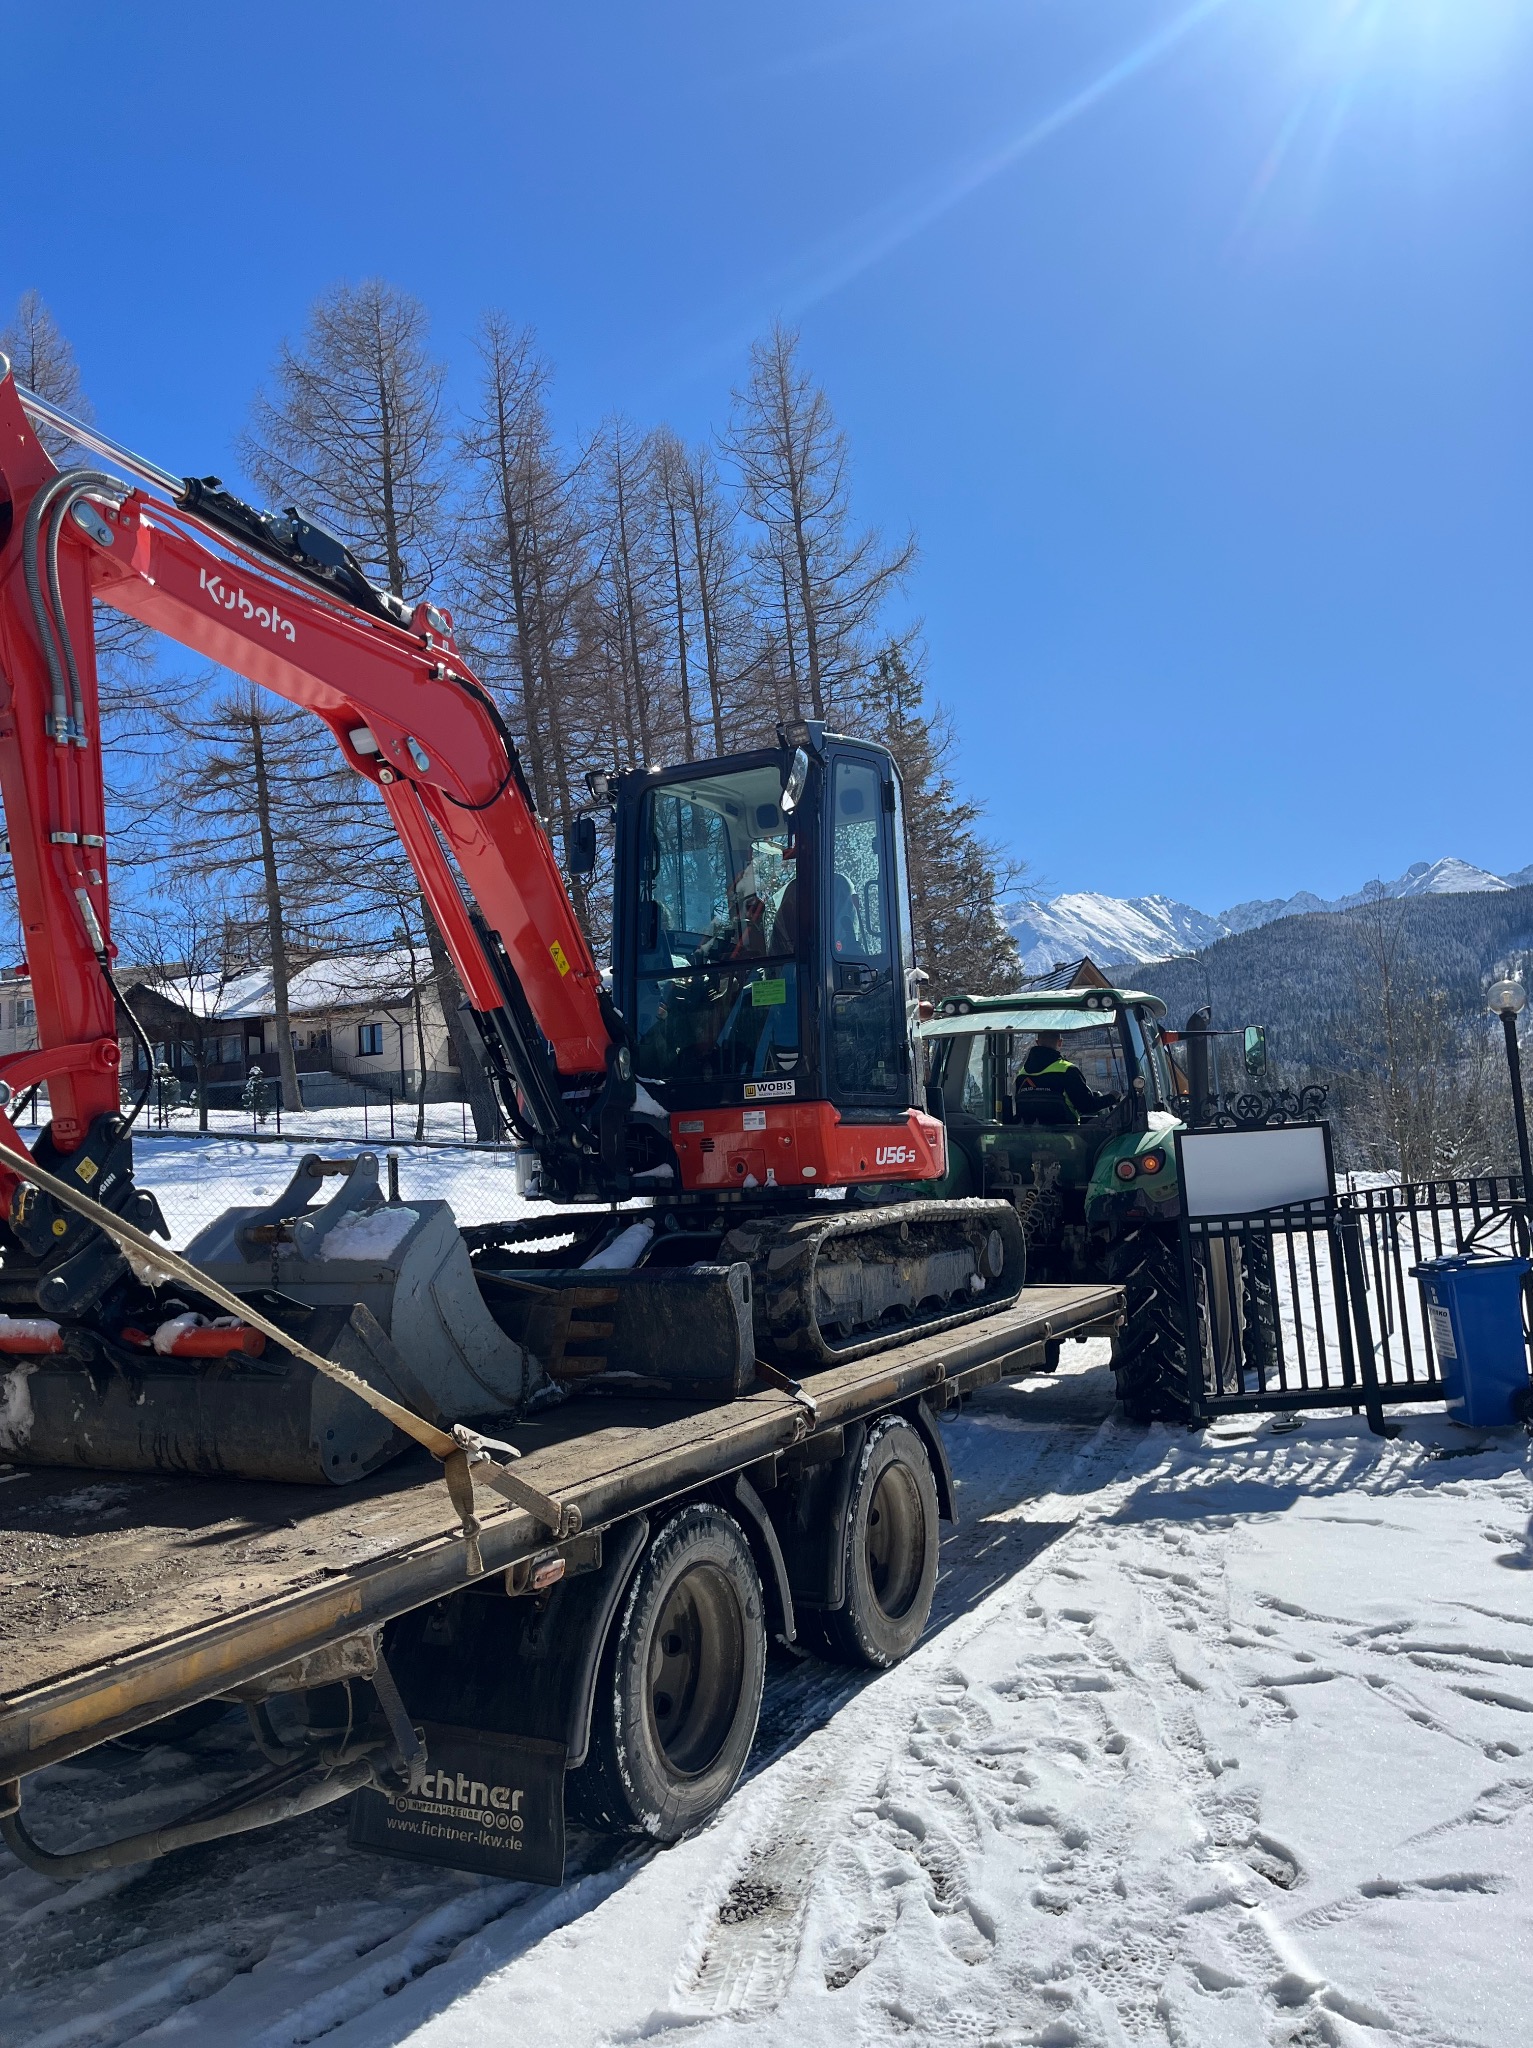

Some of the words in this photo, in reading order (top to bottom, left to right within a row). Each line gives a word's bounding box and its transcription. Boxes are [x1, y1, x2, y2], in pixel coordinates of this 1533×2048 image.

[200, 567, 296, 643] Kubota
[757, 1081, 793, 1092] WOBIS
[875, 1145, 916, 1165] U56-5
[99, 1172, 117, 1195] GINI
[402, 1769, 524, 1812] chtner
[412, 1800, 480, 1819] NUTZFAHRZEUGE
[386, 1816, 524, 1851] www.fichtner-lkw.de
